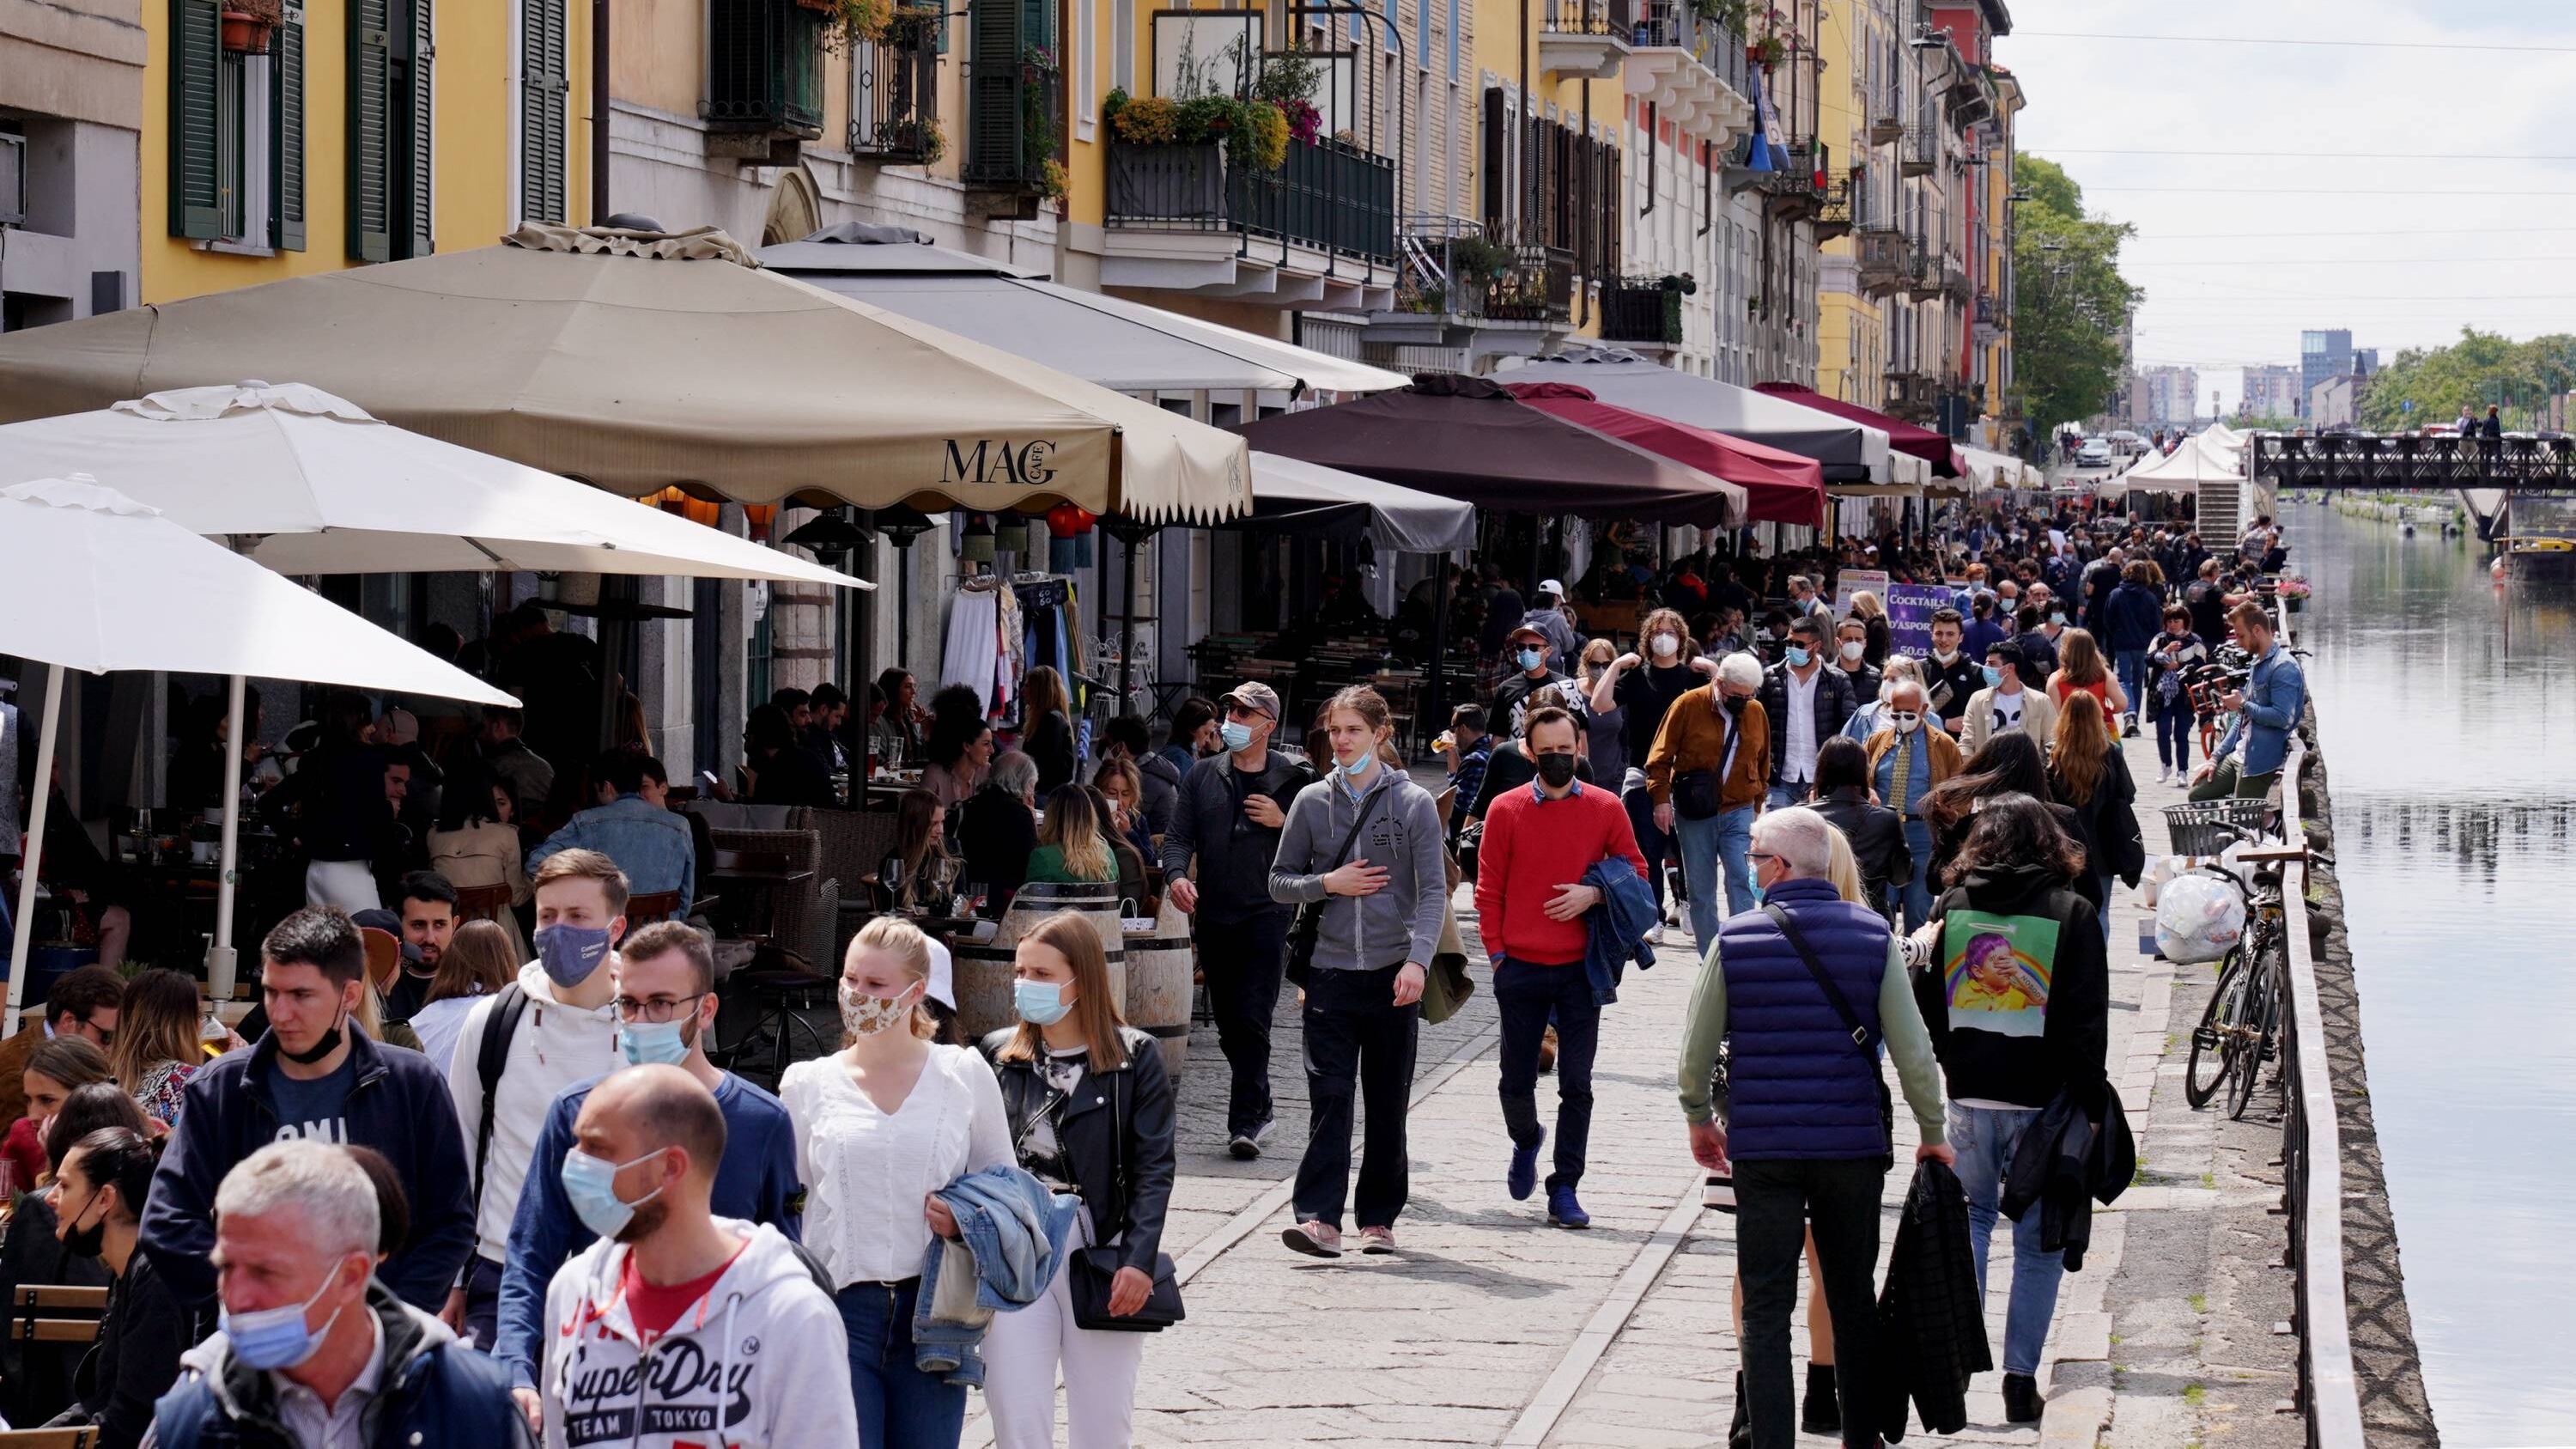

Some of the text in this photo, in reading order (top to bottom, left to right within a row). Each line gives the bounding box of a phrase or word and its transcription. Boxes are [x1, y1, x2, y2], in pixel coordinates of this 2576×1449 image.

[939, 439, 1058, 485] MAG
[1889, 594, 1945, 607] COCKTAILS
[1888, 620, 1932, 631] D'ASPOR
[573, 1409, 711, 1440] TEAM TOKYO
